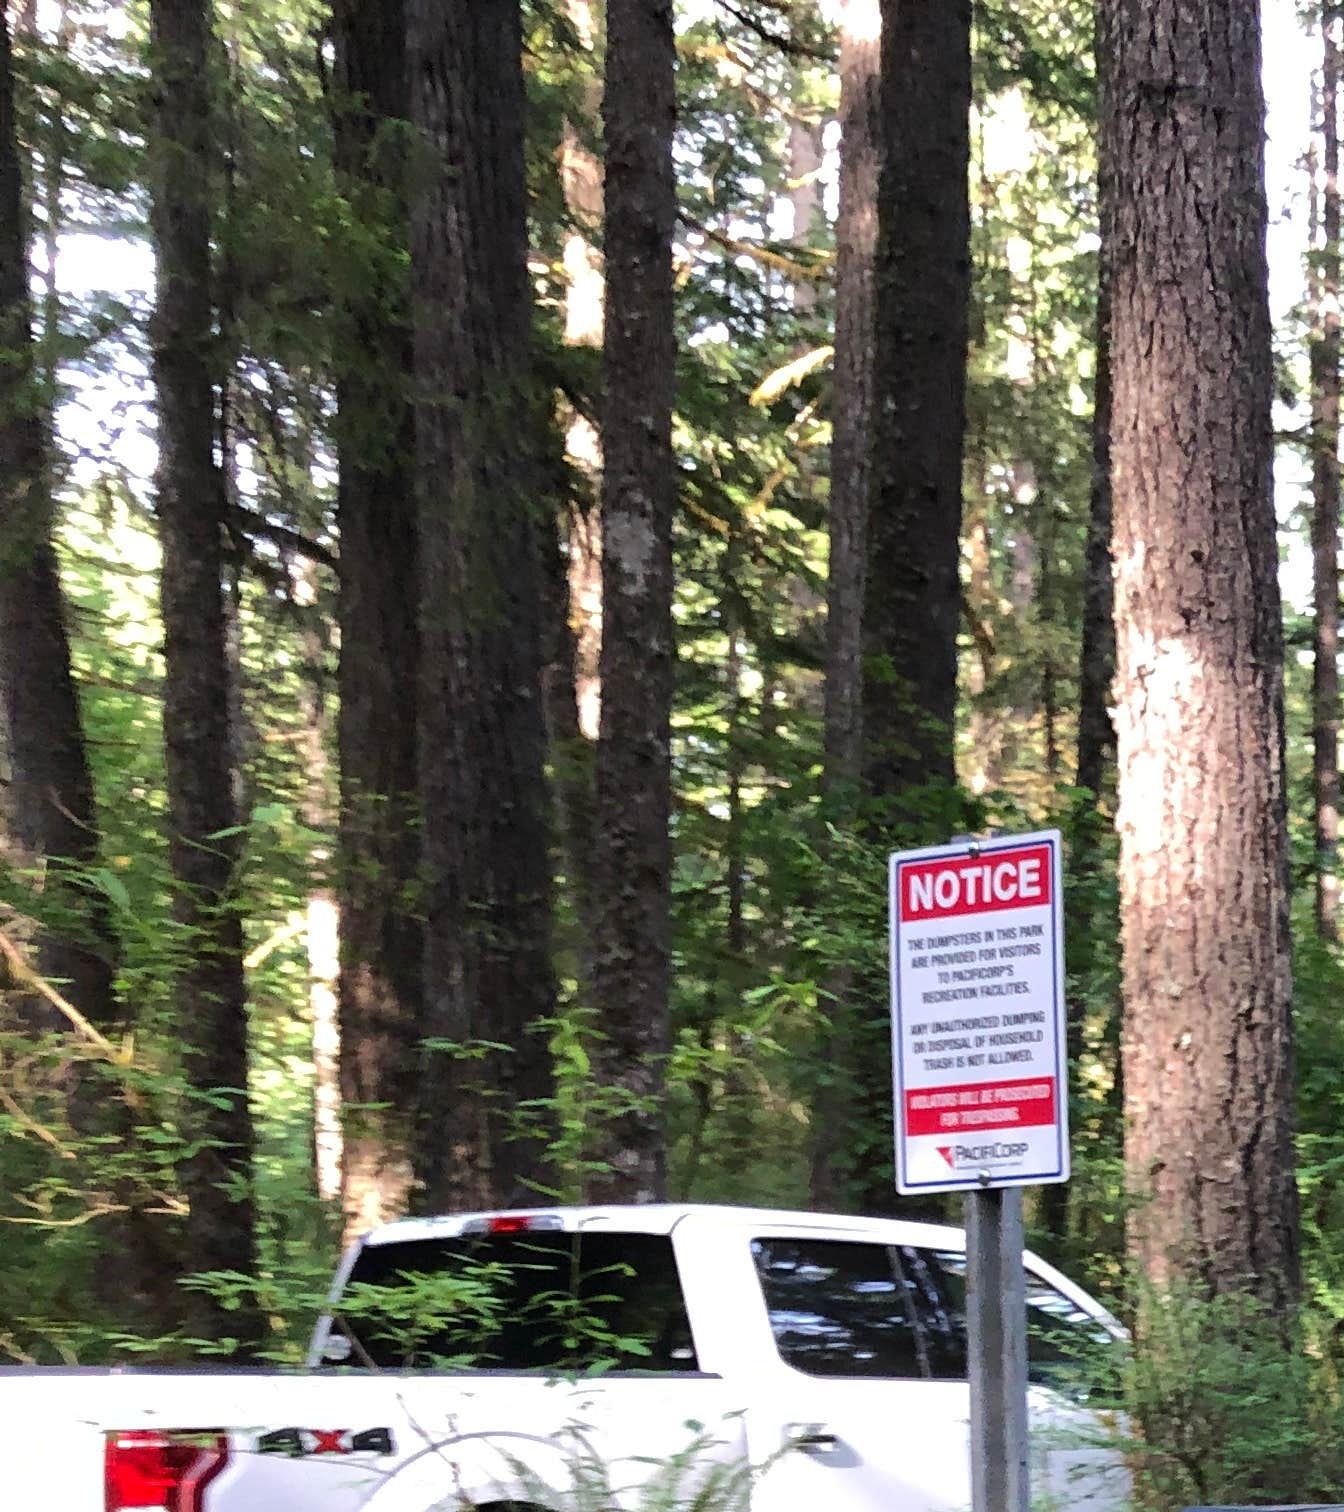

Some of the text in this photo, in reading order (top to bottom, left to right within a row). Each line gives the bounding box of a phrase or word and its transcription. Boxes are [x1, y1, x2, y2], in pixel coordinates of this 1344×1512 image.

[909, 858, 1042, 912] NOTICE
[908, 924, 1044, 951] THE DUMPSTERS IN THIS PARK
[911, 943, 1042, 969] ARE PROVIDED FOR VISITORS
[938, 971, 950, 984] TO
[921, 981, 1031, 1004] RECREATION FACILITIES.
[910, 1010, 1046, 1036] ANY UNAUTHORIZED DUMPING
[913, 1030, 1044, 1054] OR DISPOSAL OF HOUSEHOLD
[923, 1049, 1034, 1071] TRASH IS NOT ALLOWED.
